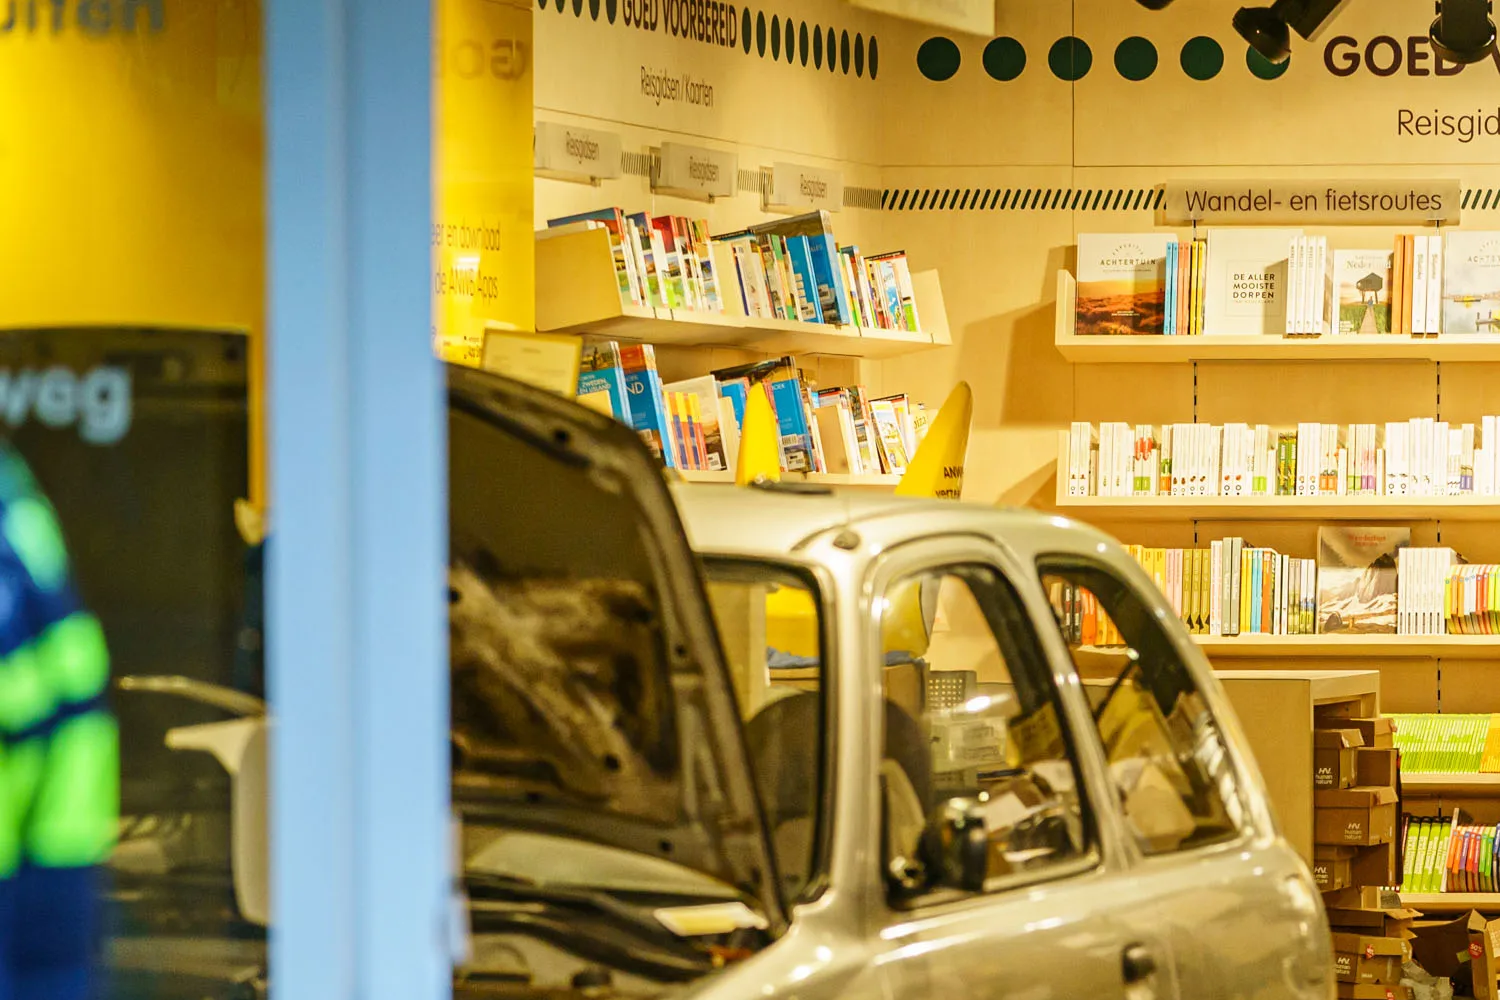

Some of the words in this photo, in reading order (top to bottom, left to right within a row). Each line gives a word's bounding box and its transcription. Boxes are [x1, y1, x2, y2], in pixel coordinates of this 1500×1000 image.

[623, 0, 658, 32] GOED
[663, 0, 737, 48] VOORBEREID
[640, 66, 681, 106] Reisgidsen
[687, 76, 714, 107] Kaarten
[565, 131, 600, 162] Reisgidsen
[689, 155, 720, 182] Reisgidsen
[1186, 189, 1283, 212] Wandel-
[1290, 192, 1318, 210] en
[1325, 187, 1442, 211] fietsroutes
[1233, 273, 1245, 281] DE
[1248, 273, 1275, 281] ALLER
[1233, 282, 1275, 290] MOOISTE
[1232, 291, 1274, 299] DORPEN
